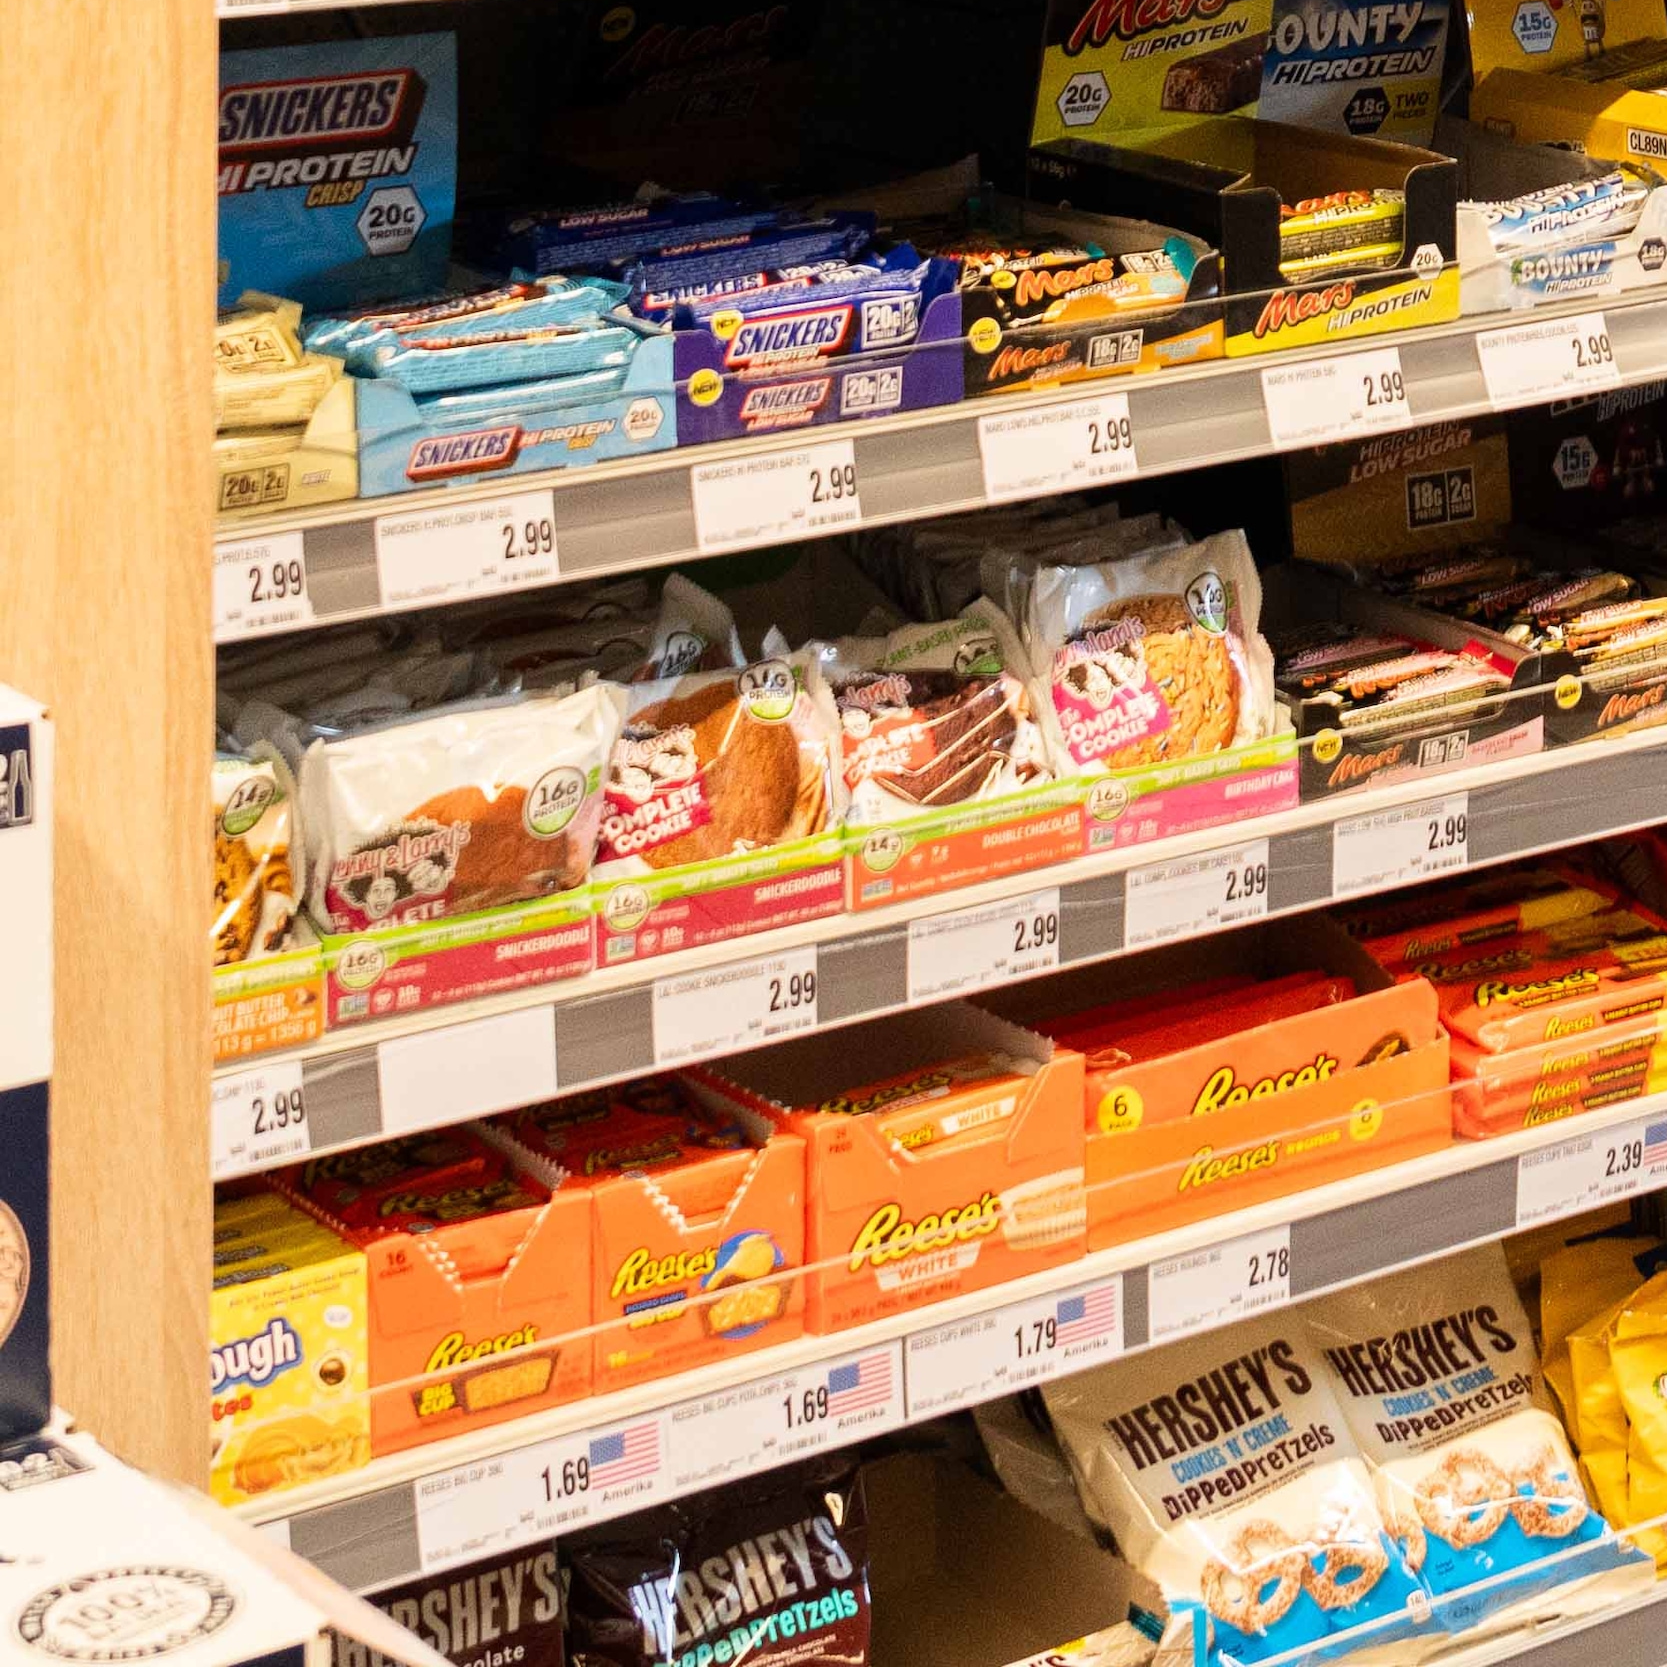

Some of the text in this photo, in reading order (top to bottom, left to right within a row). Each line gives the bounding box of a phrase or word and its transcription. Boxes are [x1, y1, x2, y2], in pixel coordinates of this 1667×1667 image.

[219, 81, 400, 143] SNICKERS
[305, 179, 364, 206] CRISP
[1522, 248, 1604, 285] BOUNTY
[1252, 281, 1355, 337] Mars
[734, 313, 851, 359] SNICKERS
[745, 383, 829, 416] SNICKERS
[1363, 373, 1406, 406] 2.99
[412, 431, 516, 476] SNICKERS
[1088, 417, 1132, 453] 2.99
[809, 465, 856, 503] 2.99
[502, 520, 554, 559] 2.99
[249, 561, 301, 602] 2.99
[1079, 718, 1148, 756] COOKIE
[1317, 739, 1340, 755] NEW
[983, 813, 1080, 848] DOUBLE CHOCOLATE
[1428, 813, 1467, 850] 2.99
[1226, 865, 1266, 901] 2.99
[1015, 914, 1057, 951] 2.99
[769, 971, 816, 1009] 2.99
[251, 1091, 306, 1131] 2.99
[1113, 1094, 1128, 1113] 6
[1178, 1140, 1280, 1190] Reese's
[850, 1192, 1002, 1270] Reese's
[611, 1245, 718, 1297] Reese's
[899, 1253, 959, 1279] WHITE
[1248, 1250, 1289, 1286] 2.78
[424, 1323, 538, 1372] Reese's
[1014, 1320, 1057, 1358] 1.79
[1325, 1306, 1519, 1397] HERSHEY'S
[419, 1395, 455, 1416] CUP
[424, 1383, 455, 1399] BIG
[782, 1386, 829, 1428] 1.69
[1108, 1341, 1314, 1470] HERSHEY'S
[541, 1458, 591, 1501] 1.69
[631, 1517, 854, 1653] HERSHEY'S
